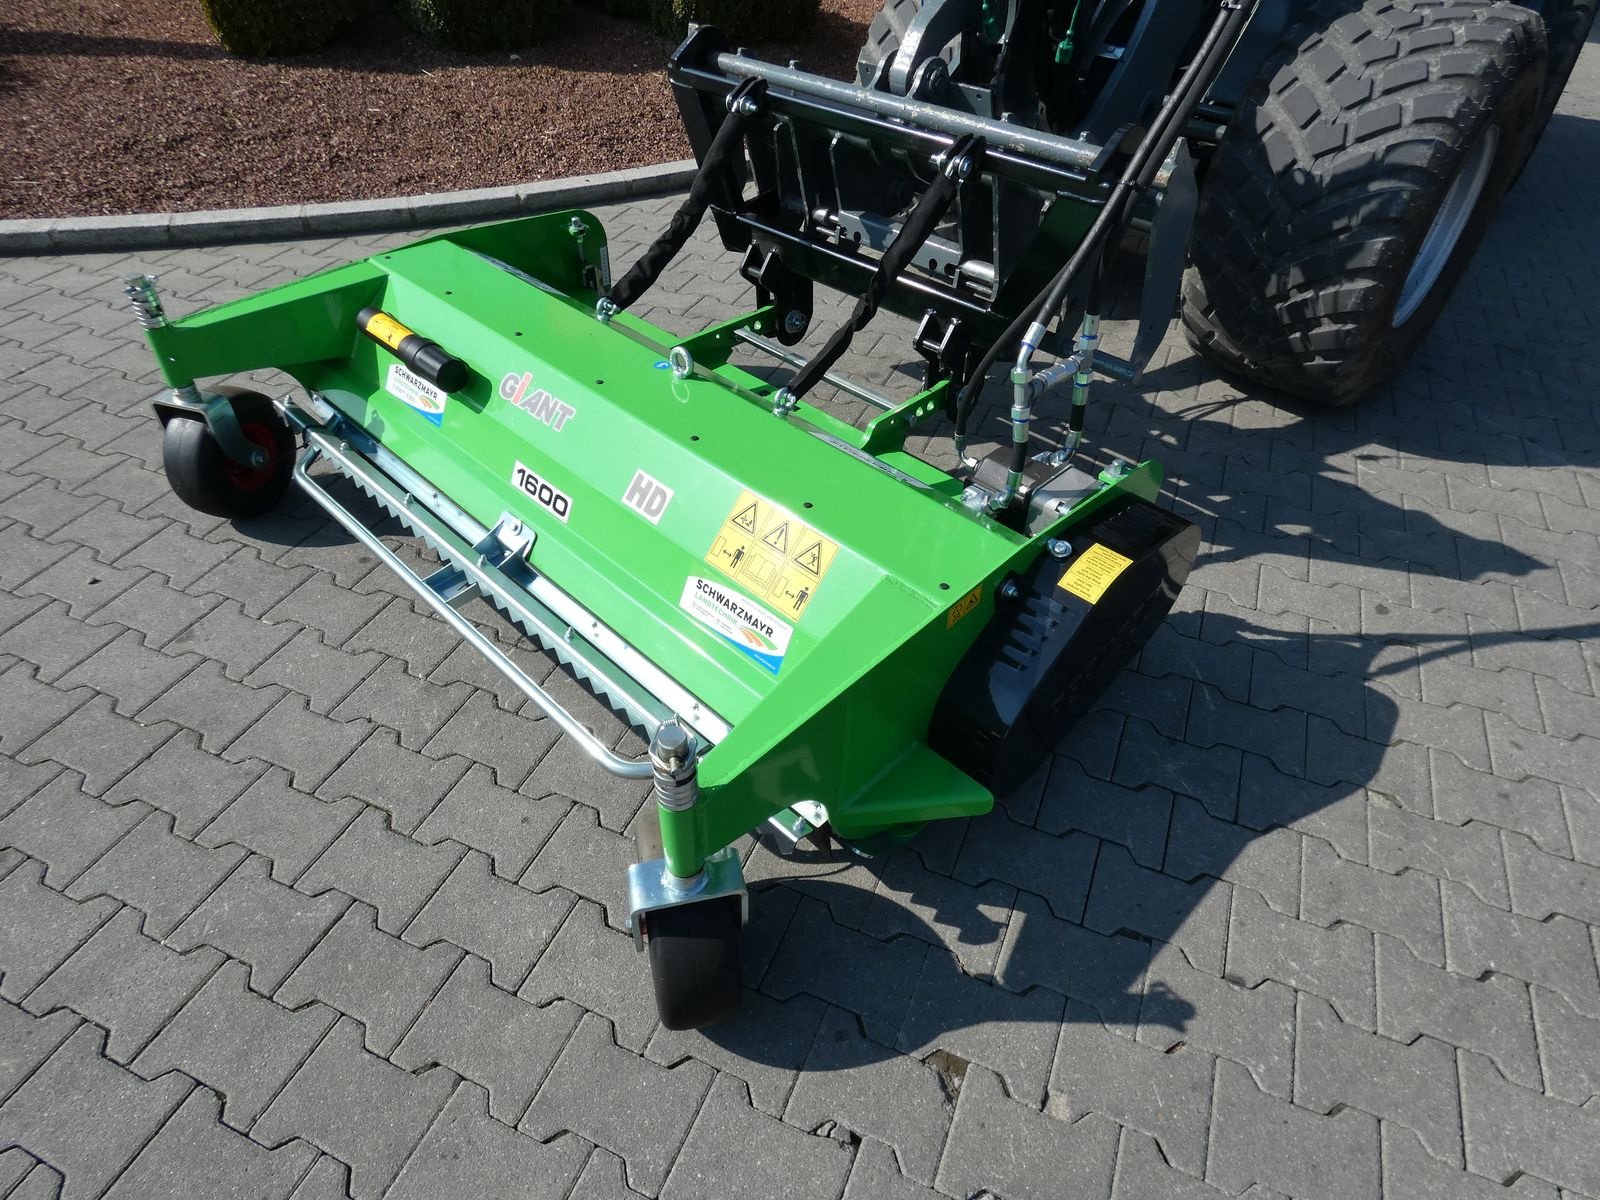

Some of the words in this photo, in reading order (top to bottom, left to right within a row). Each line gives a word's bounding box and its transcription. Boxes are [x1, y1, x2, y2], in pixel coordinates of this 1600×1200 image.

[394, 365, 438, 400] SCHWARZMAYR
[500, 371, 576, 432] GIANT
[517, 468, 569, 517] 1600
[625, 472, 668, 518] HD
[694, 592, 738, 626] LANDTECHNIK
[696, 579, 774, 638] SCHWARZMAYR
